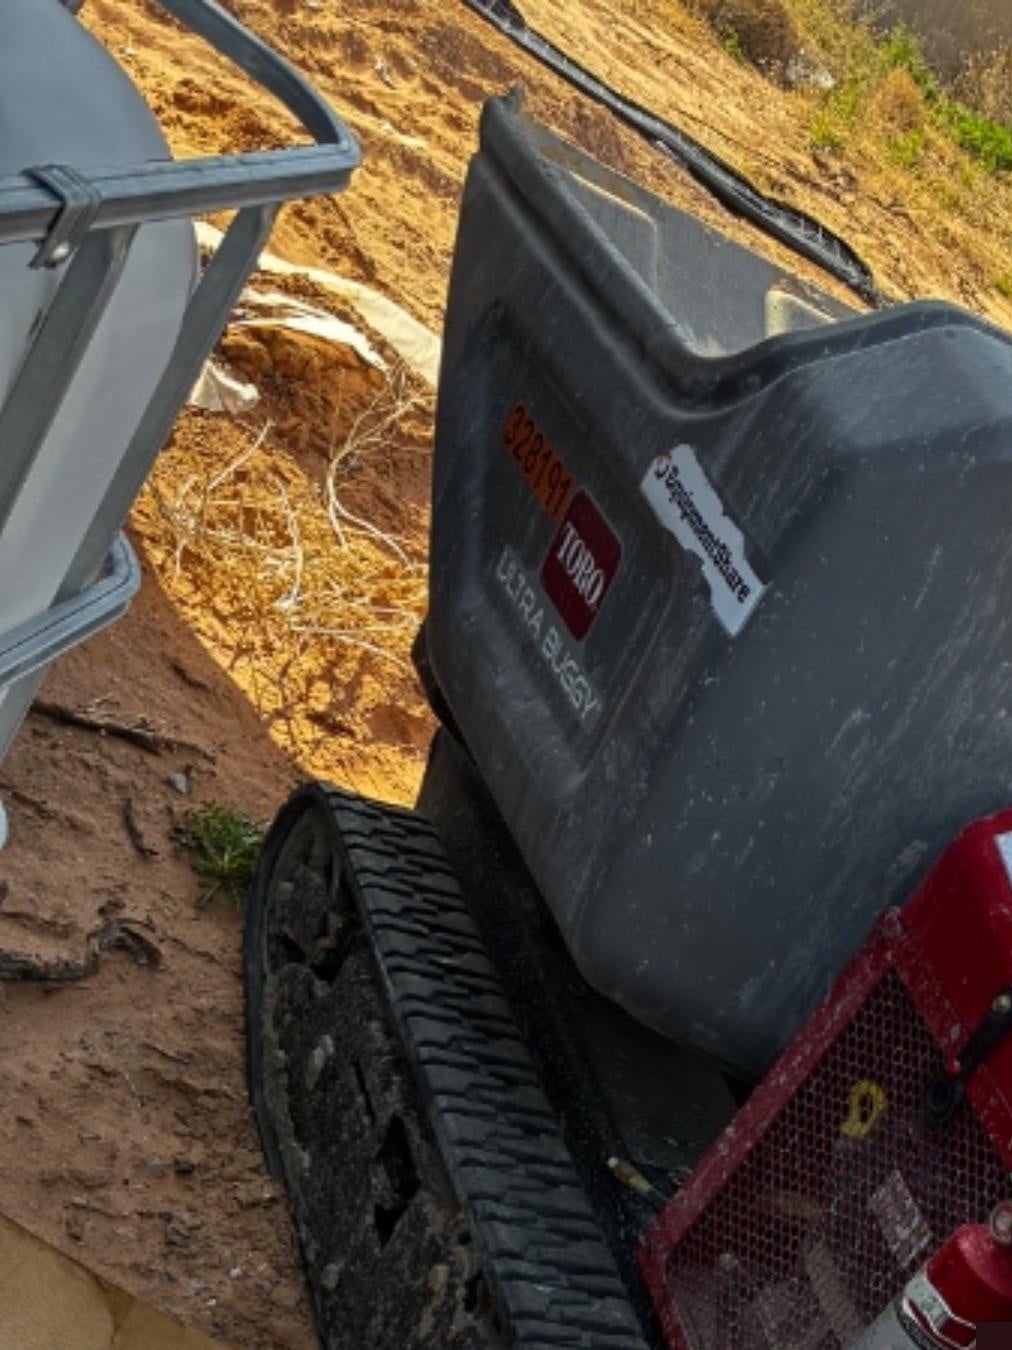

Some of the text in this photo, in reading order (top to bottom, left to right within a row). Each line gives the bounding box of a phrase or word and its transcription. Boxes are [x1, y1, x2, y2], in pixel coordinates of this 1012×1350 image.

[503, 404, 574, 518] 328191
[557, 523, 606, 608] TORO
[664, 464, 753, 603] EquipmentShare
[496, 547, 602, 718] ULTRA BUGGY
